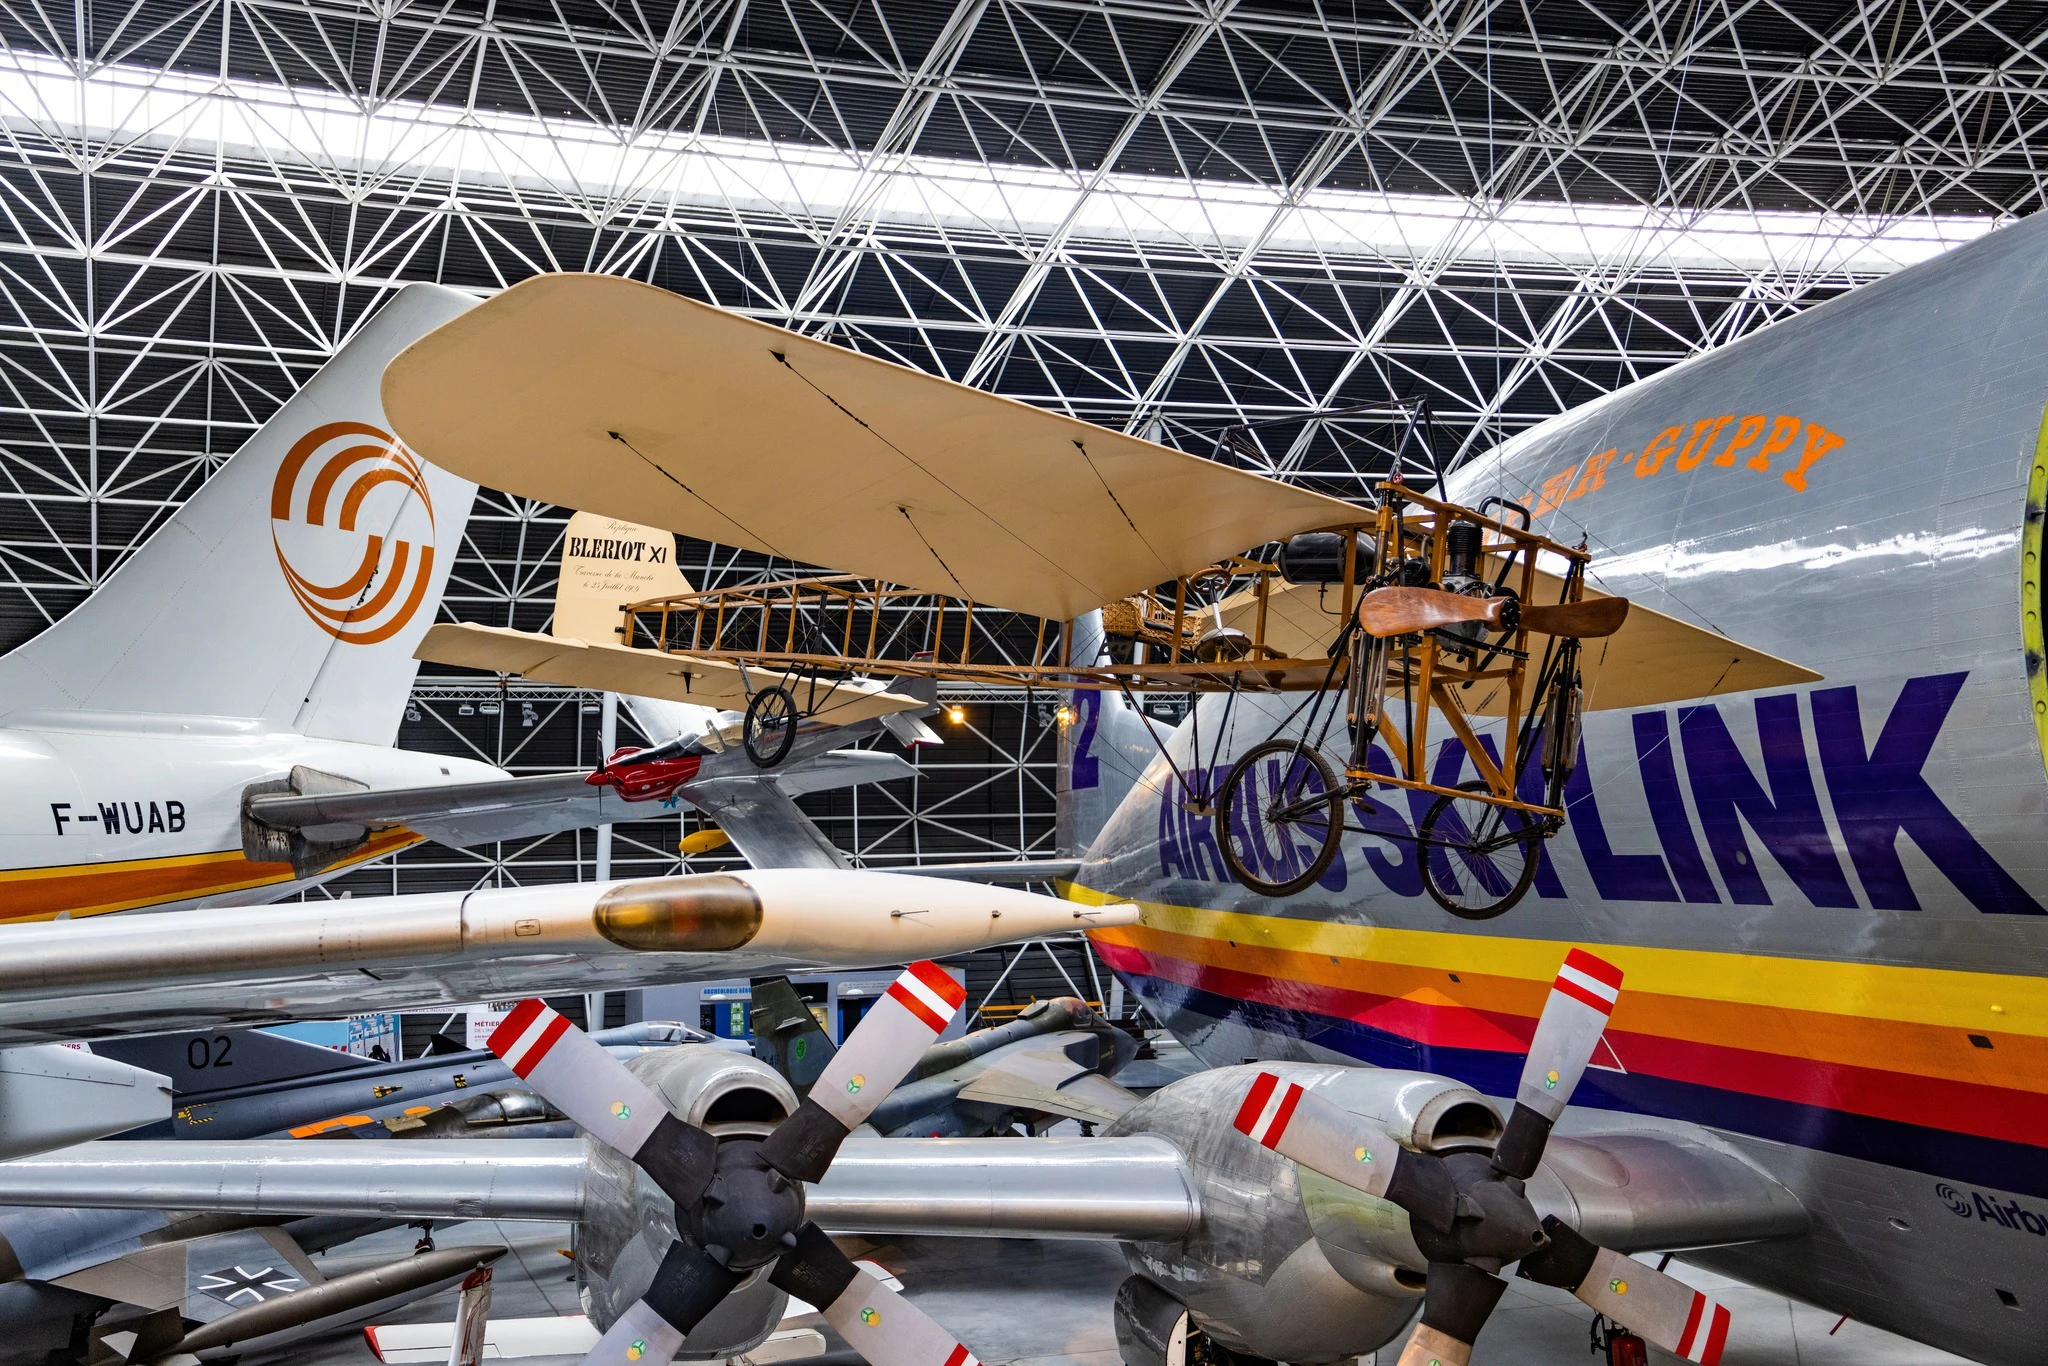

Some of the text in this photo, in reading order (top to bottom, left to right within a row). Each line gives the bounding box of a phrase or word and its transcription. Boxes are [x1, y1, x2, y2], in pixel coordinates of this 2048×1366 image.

[568, 536, 667, 564] BLERIOT XI
[1072, 676, 1102, 790] 2
[1158, 671, 2048, 916] AIRBUS SKYLINK
[50, 800, 186, 836] F-WUAB
[187, 1035, 233, 1070] 02
